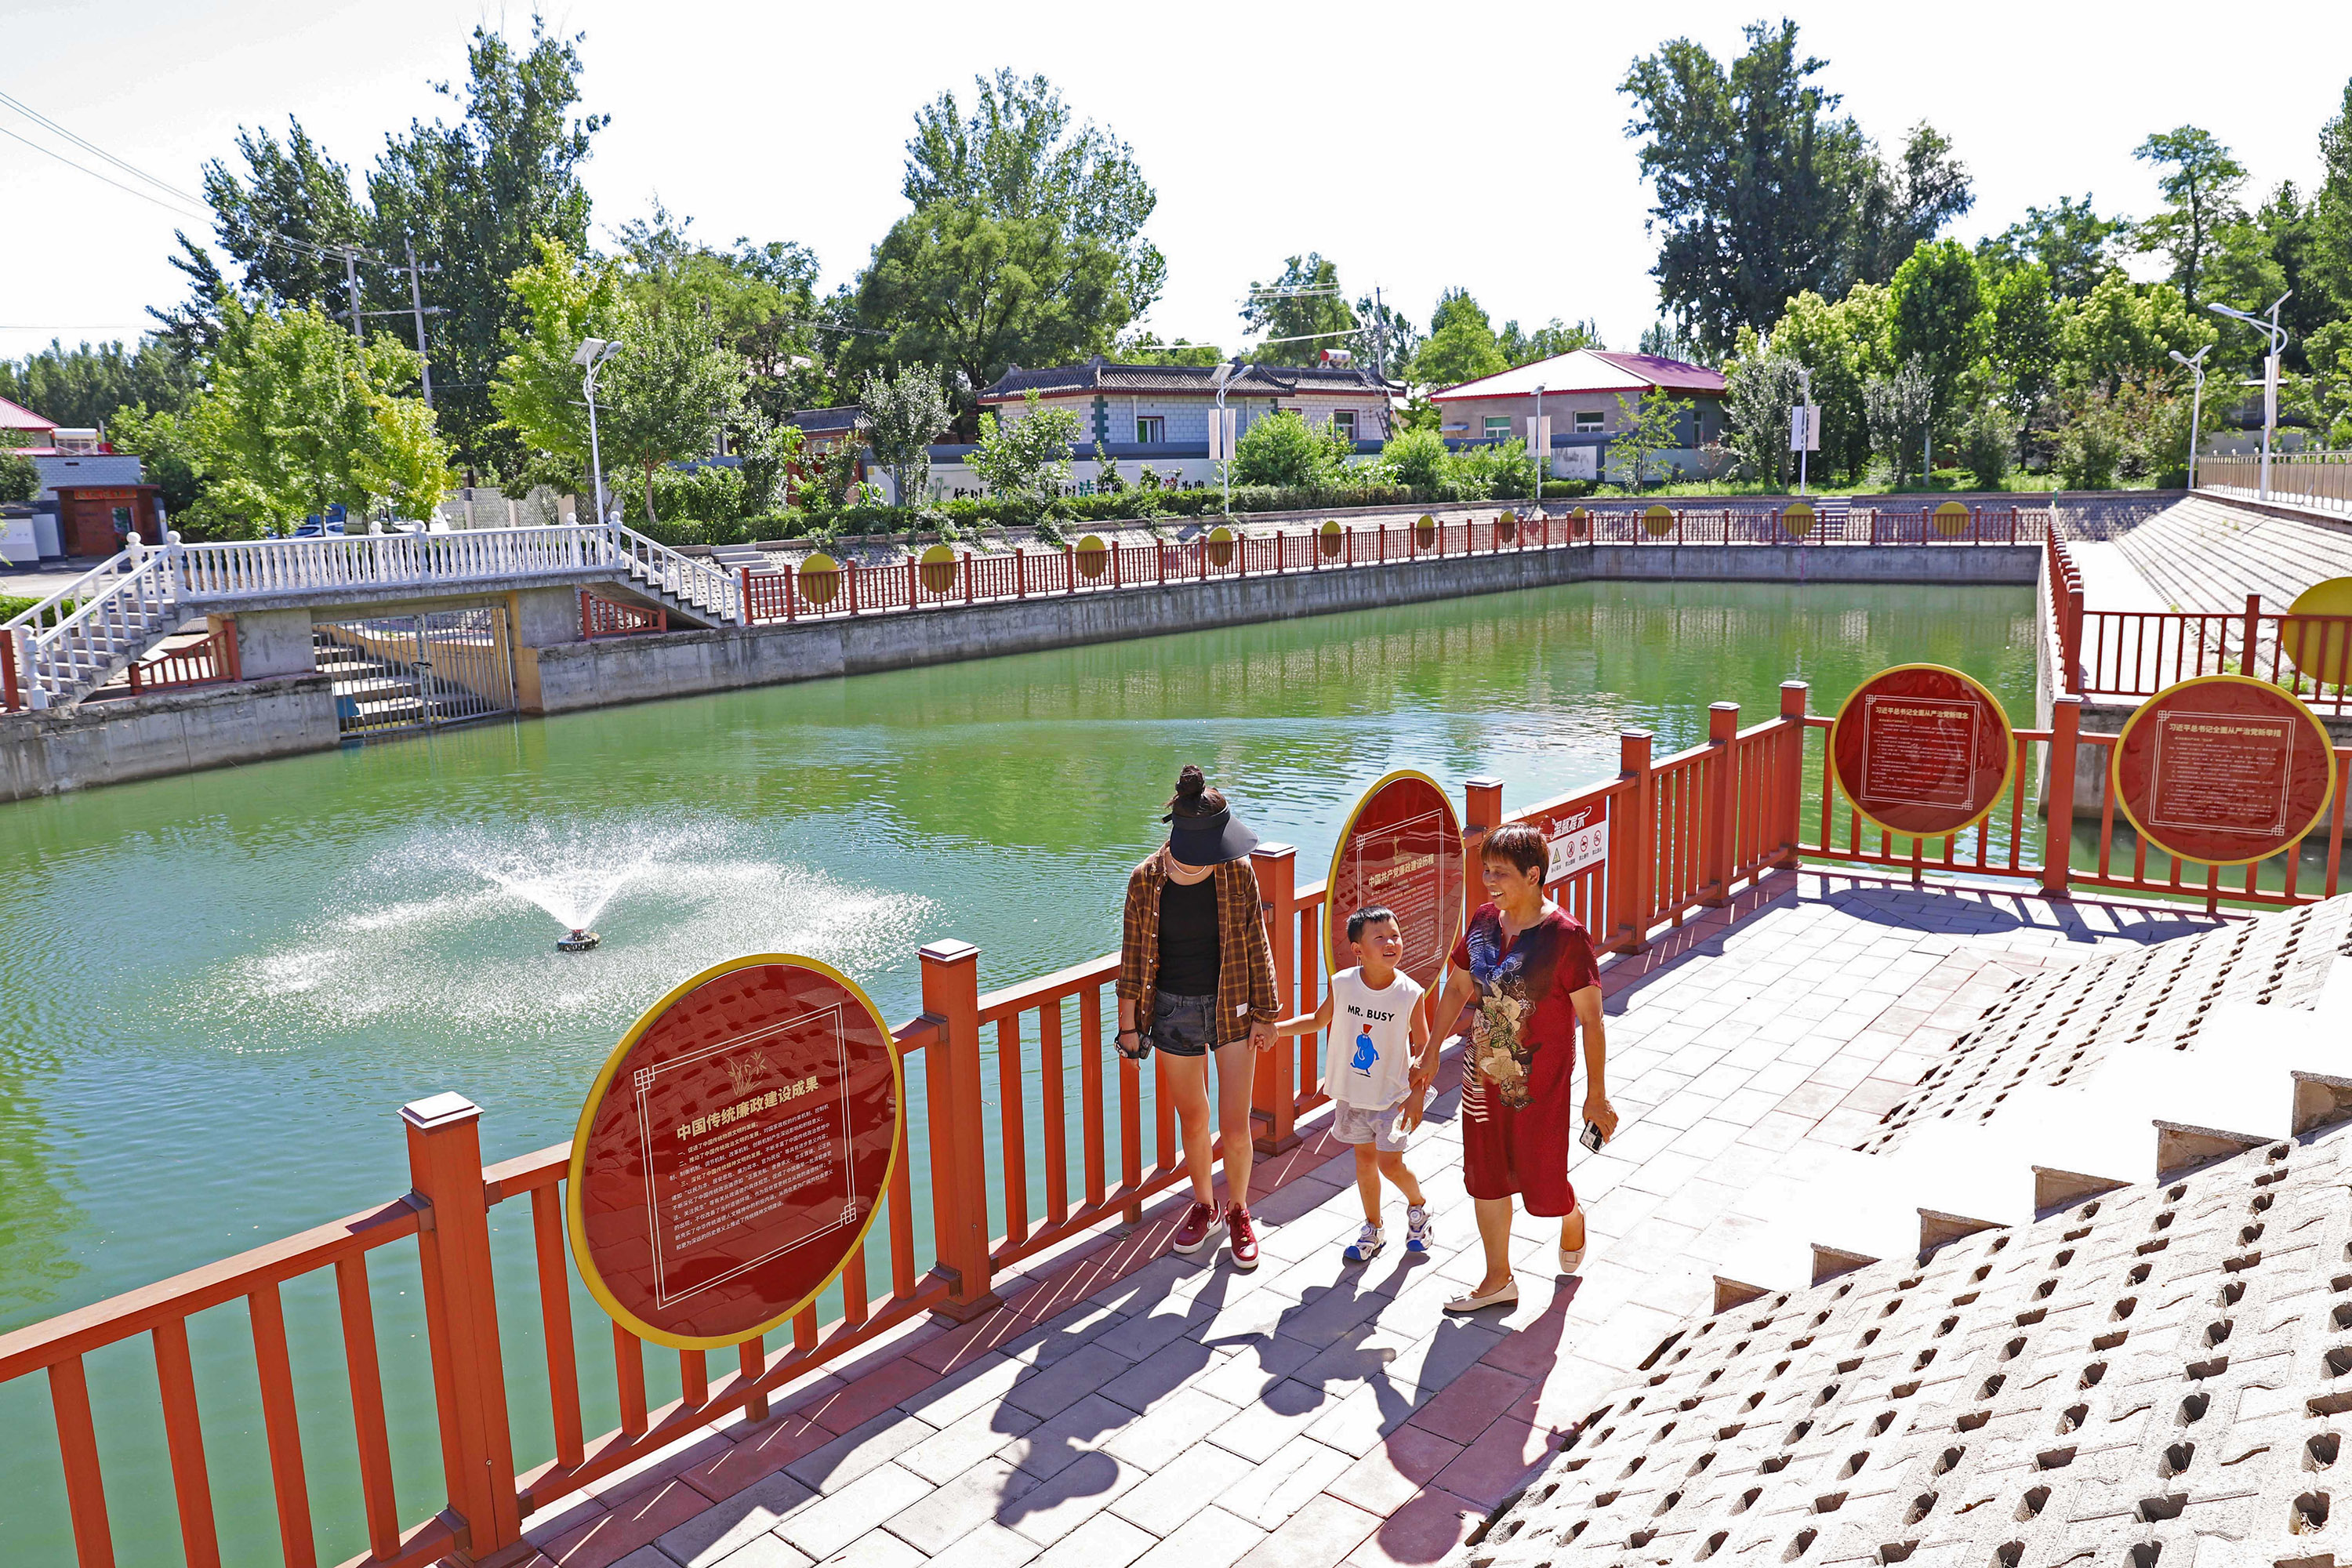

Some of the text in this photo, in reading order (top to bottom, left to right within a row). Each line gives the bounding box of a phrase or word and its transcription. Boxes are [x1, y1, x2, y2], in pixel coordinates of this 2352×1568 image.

[1875, 706, 1969, 720] 习近平总书记全面从严治党新理念
[2169, 723, 2281, 737] 习近平总书记全面从严治党新举措
[1550, 806, 1592, 840] 温馨提示
[1368, 853, 1434, 887] 中国共产党廉政建设历程
[1348, 1004, 1395, 1022] MR. BUSY
[677, 1075, 819, 1142] 中国传统廉政建设成果
